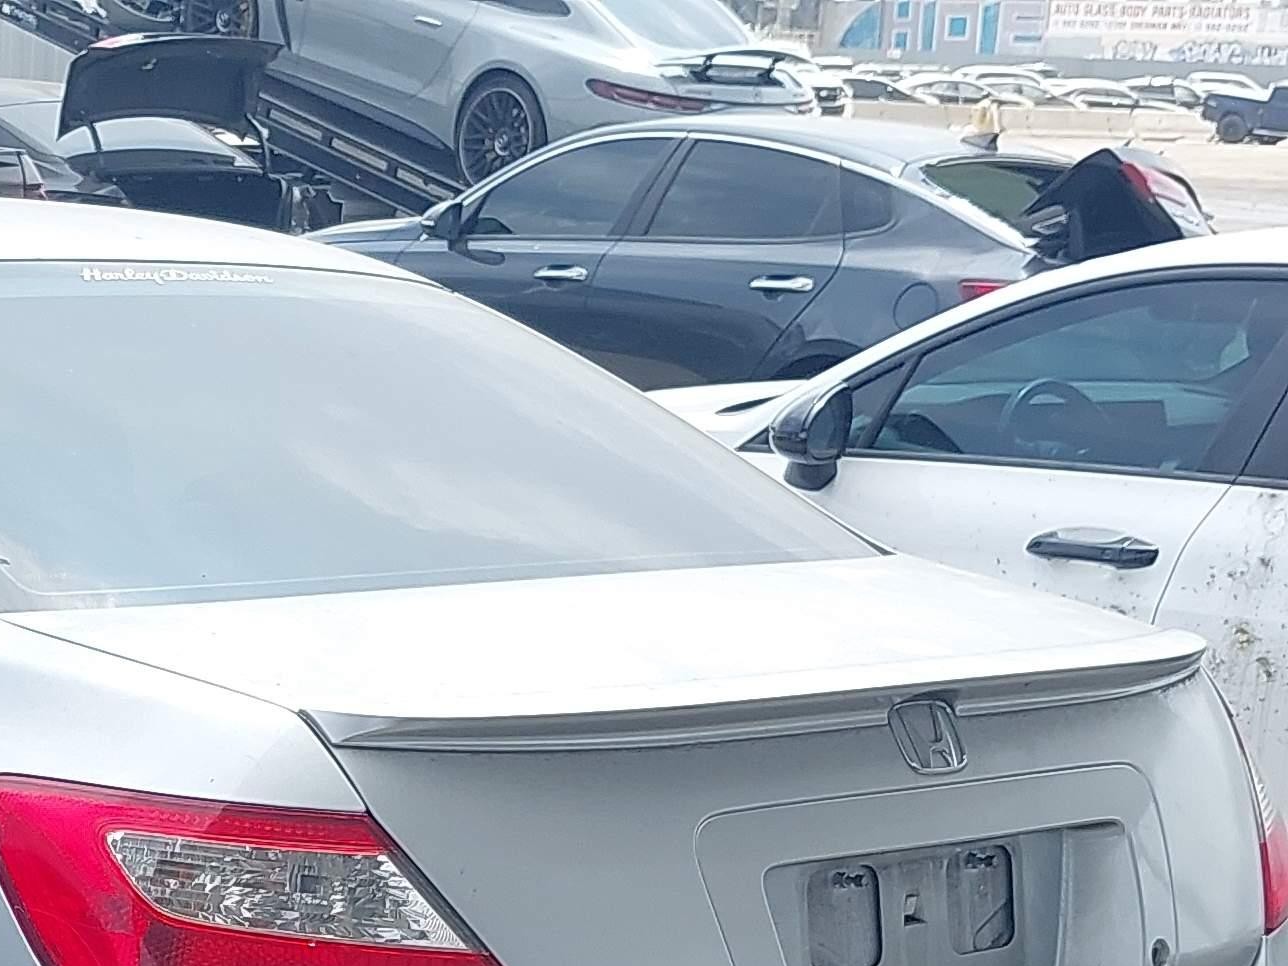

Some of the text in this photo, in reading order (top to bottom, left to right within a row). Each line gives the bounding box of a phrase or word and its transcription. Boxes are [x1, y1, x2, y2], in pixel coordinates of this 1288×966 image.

[1053, 3, 1080, 16] AUTO
[1083, 4, 1115, 17] GLASS
[1119, 5, 1147, 17] BODY
